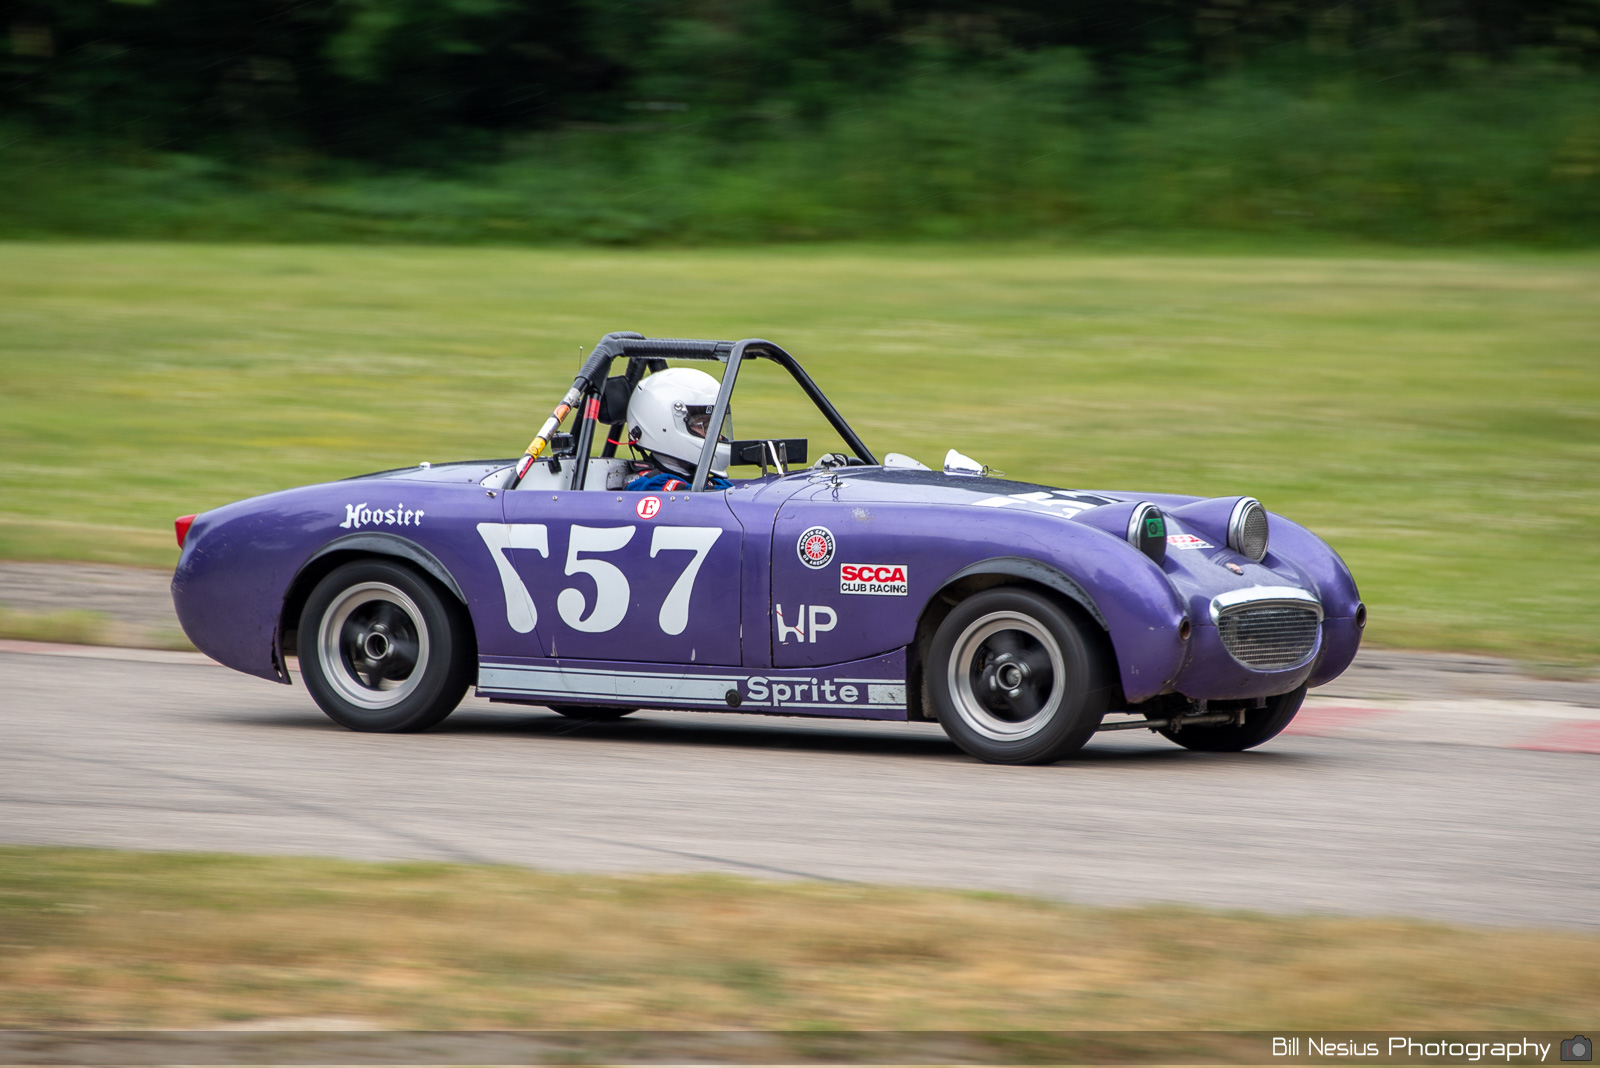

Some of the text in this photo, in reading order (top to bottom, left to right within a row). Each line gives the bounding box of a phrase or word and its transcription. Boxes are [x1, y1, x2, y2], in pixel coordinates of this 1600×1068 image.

[339, 502, 425, 529] Hoosier
[640, 499, 656, 516] E
[800, 531, 814, 550] SPORTS
[809, 554, 830, 565] AMERICA
[476, 522, 723, 636] 757
[841, 566, 906, 583] SCCA
[841, 583, 907, 594] CLUB RACING
[747, 676, 859, 707] Sprite
